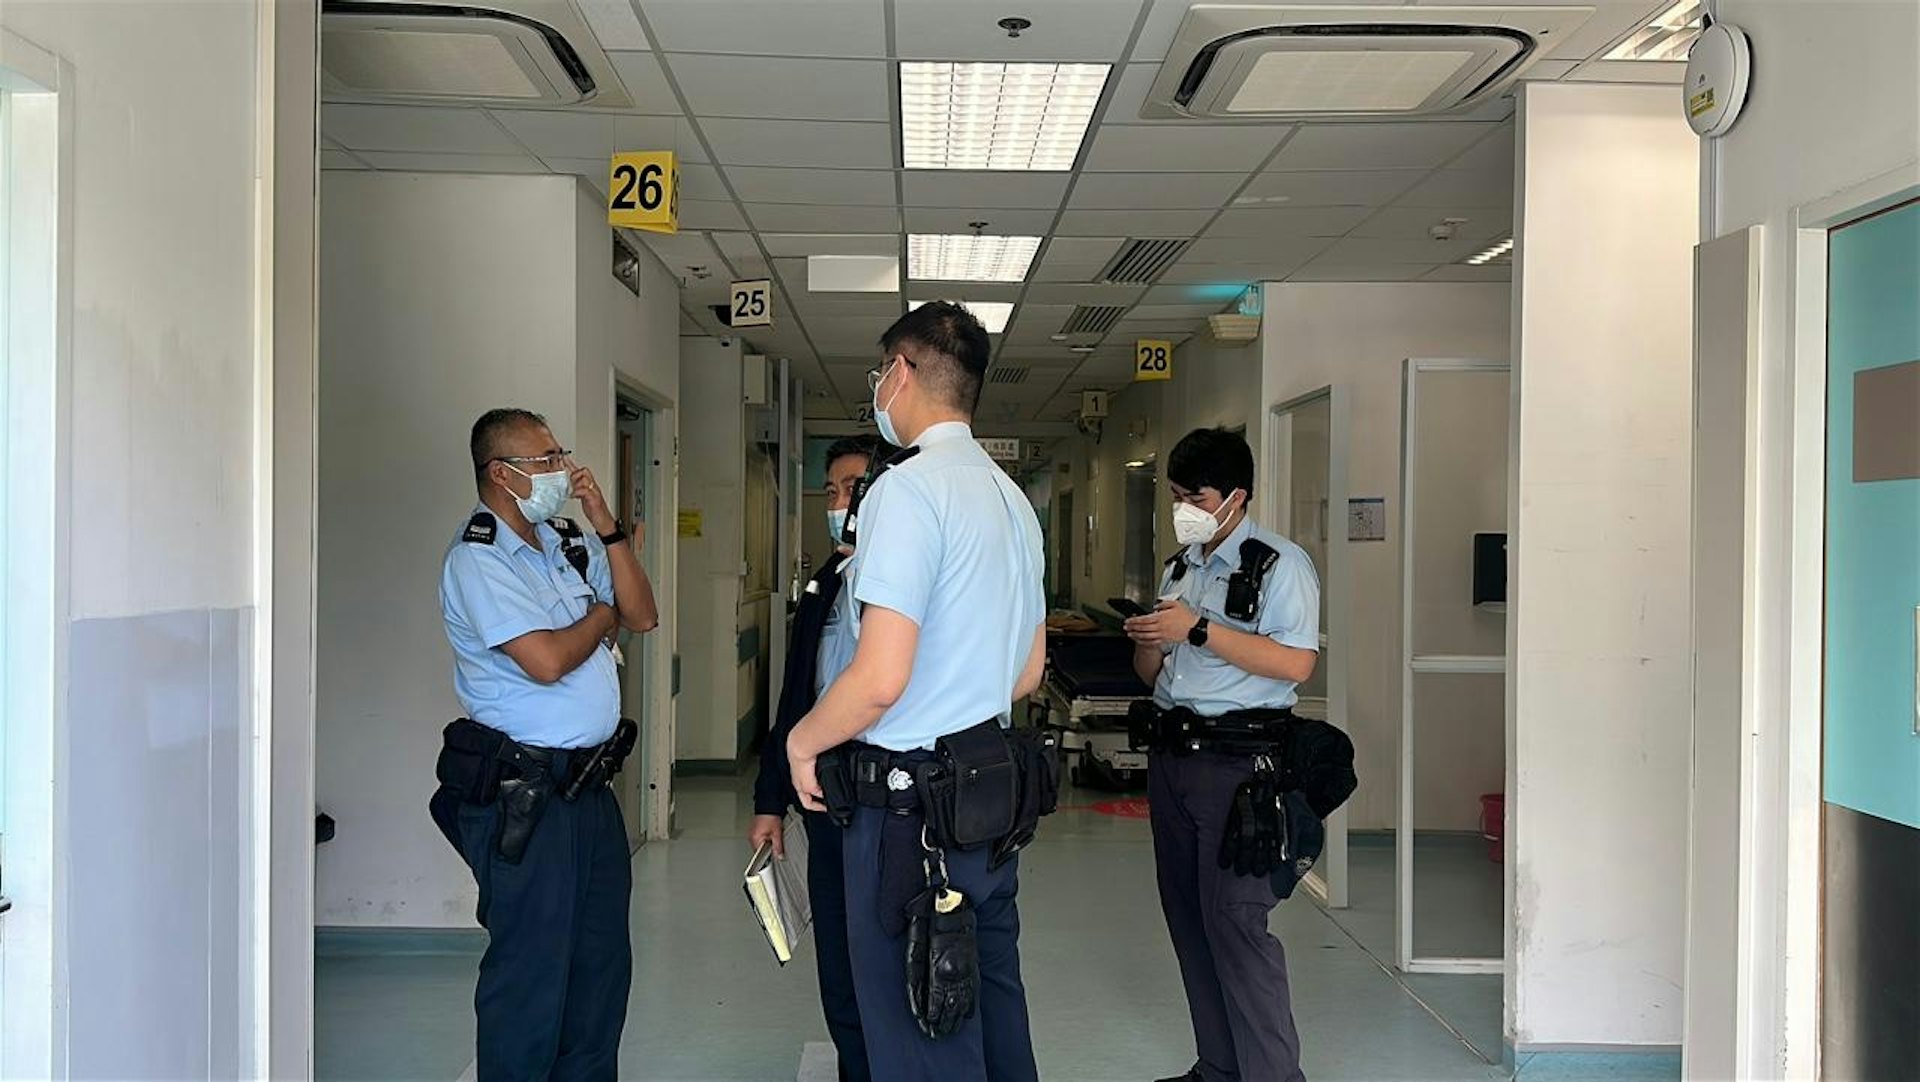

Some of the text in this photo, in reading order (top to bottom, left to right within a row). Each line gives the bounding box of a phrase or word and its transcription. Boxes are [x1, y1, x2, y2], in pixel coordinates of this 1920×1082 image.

[611, 164, 664, 210] 26
[734, 290, 765, 317] 25
[1140, 347, 1167, 371] 28
[1092, 396, 1099, 412] 1
[1033, 446, 1041, 457] 2
